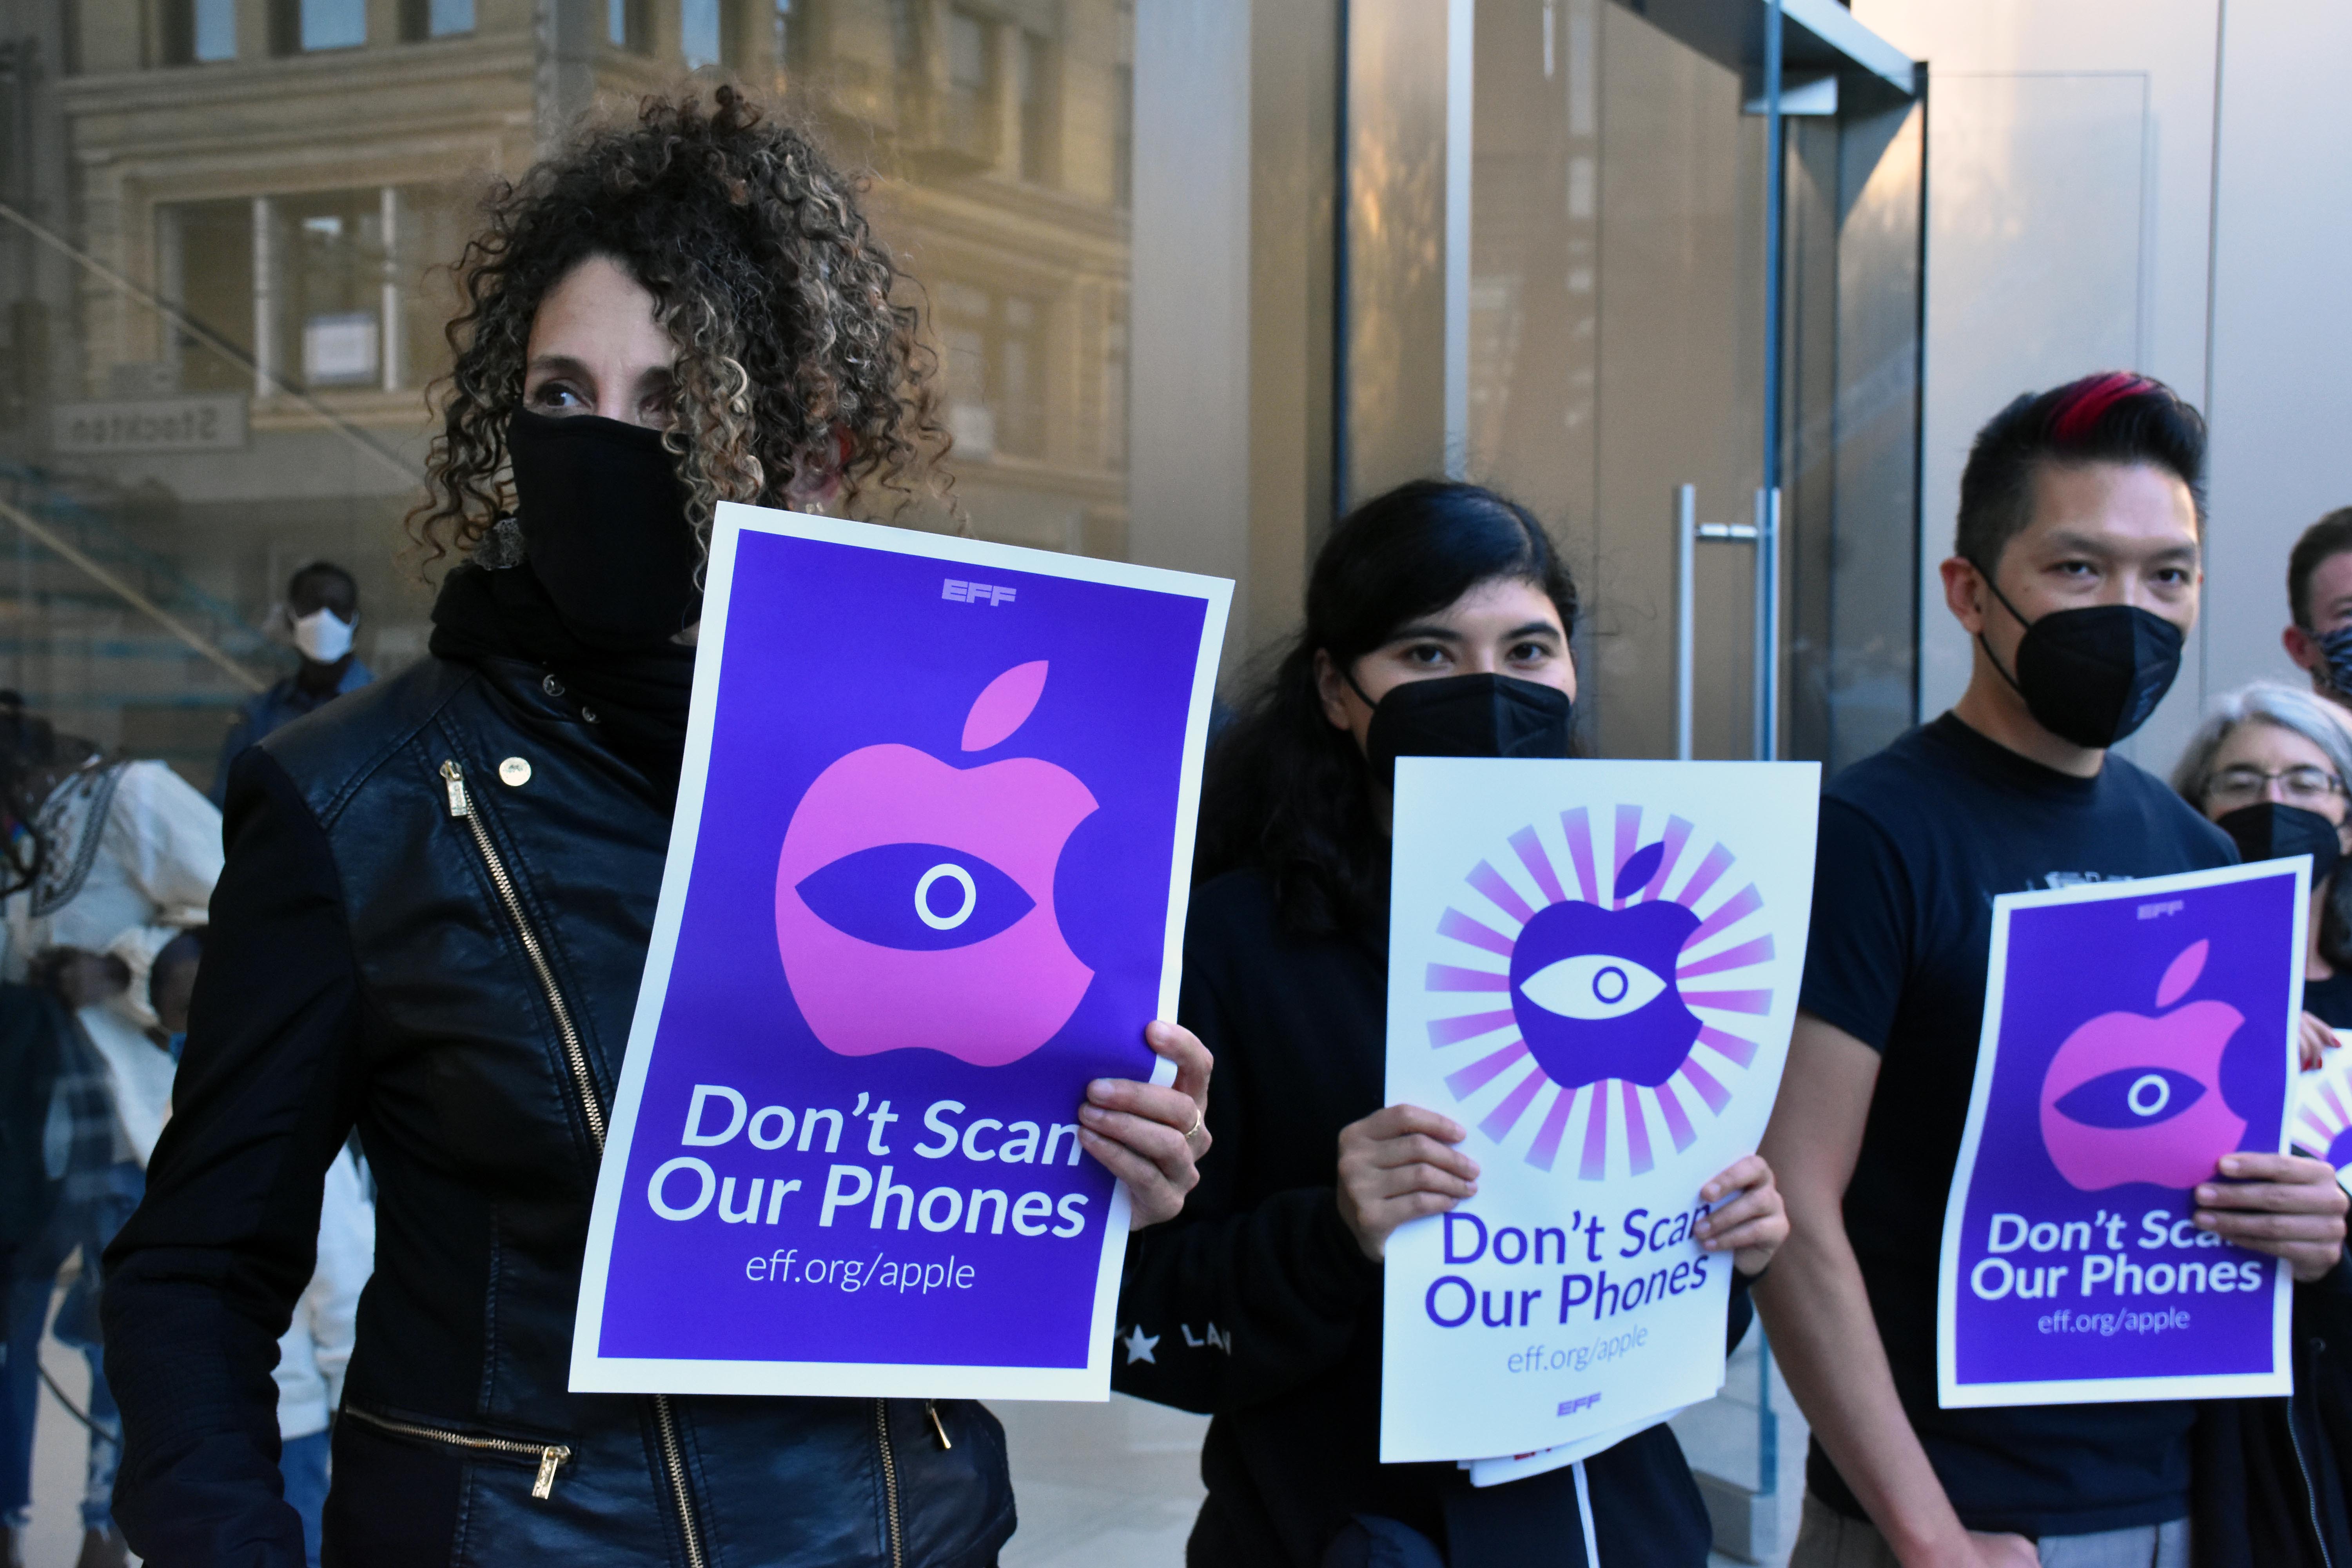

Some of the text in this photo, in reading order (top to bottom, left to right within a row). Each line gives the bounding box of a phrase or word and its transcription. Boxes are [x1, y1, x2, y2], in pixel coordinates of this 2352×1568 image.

[941, 578, 1017, 607] EFF
[2137, 900, 2185, 920] EFF
[913, 1100, 1084, 1166] Scan
[647, 1156, 1089, 1238] Our Phones
[2138, 1210, 2234, 1249] Sca
[746, 1249, 976, 1295] eff.org/apple
[1425, 1255, 1708, 1328] Our Phones
[1971, 1253, 2261, 1300] Our Phones
[2038, 1306, 2190, 1337] eff.org/apple
[1507, 1324, 1648, 1374] eff.org/apple
[1557, 1392, 1602, 1417] EFF
